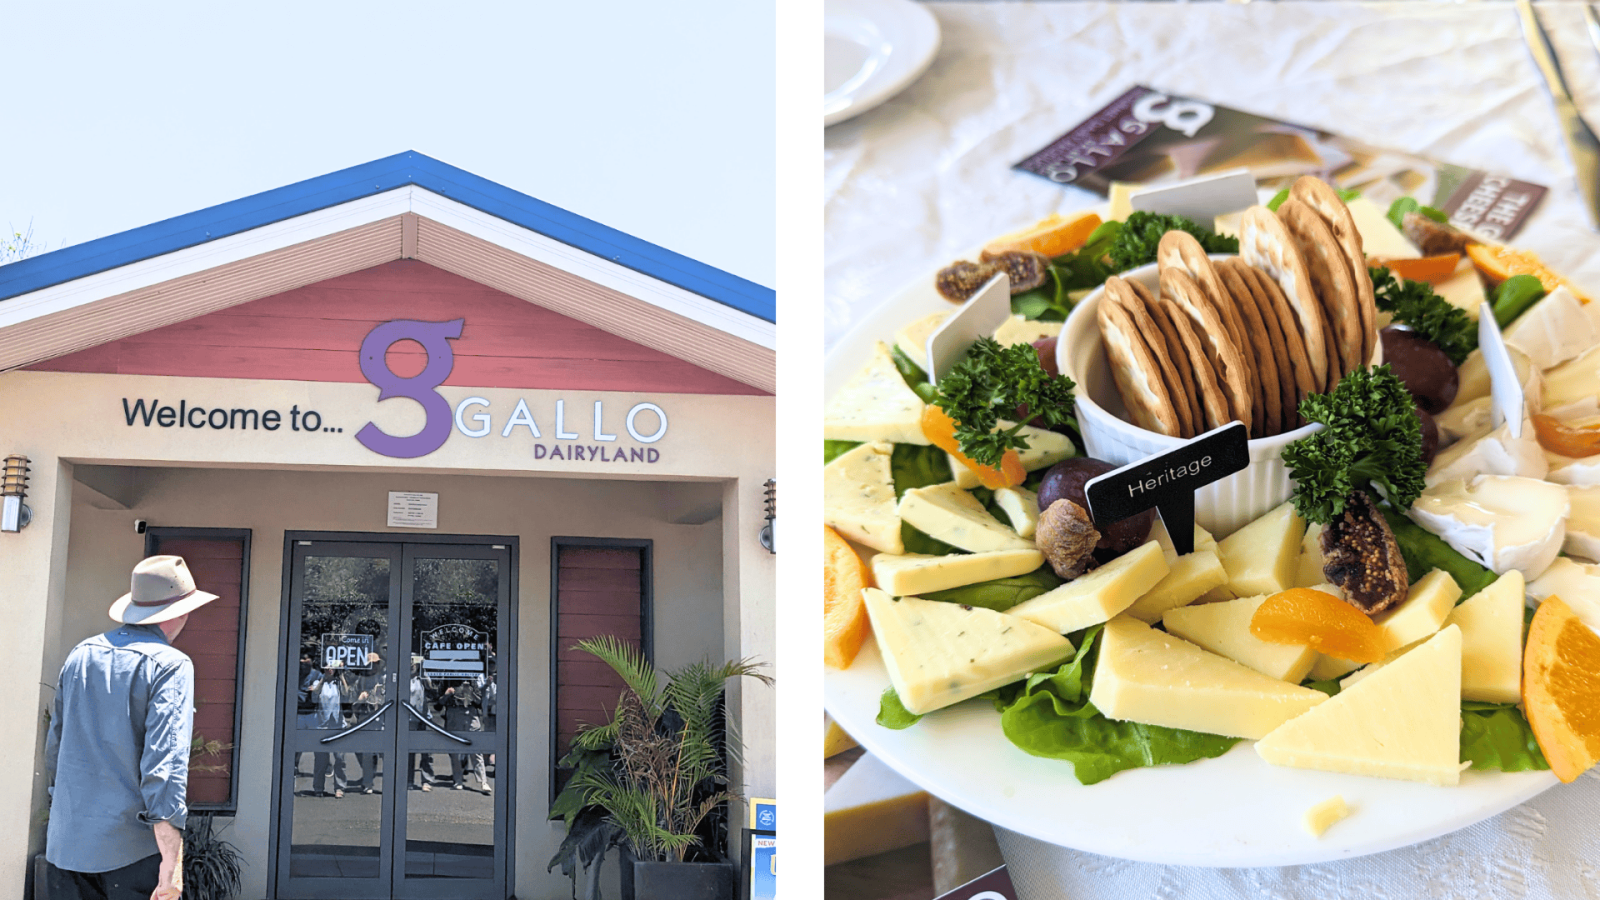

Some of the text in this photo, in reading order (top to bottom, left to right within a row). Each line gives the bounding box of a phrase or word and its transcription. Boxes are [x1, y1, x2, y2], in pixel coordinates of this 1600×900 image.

[1047, 120, 1148, 182] GALLO
[1486, 192, 1529, 225] THE
[121, 397, 281, 432] Welcome
[454, 396, 669, 445] GALLO
[532, 444, 661, 464] DAIRYLAND
[341, 635, 361, 644] Come
[429, 626, 480, 641] WELCOME
[325, 645, 369, 667] OPEN
[424, 642, 452, 650] CAFE
